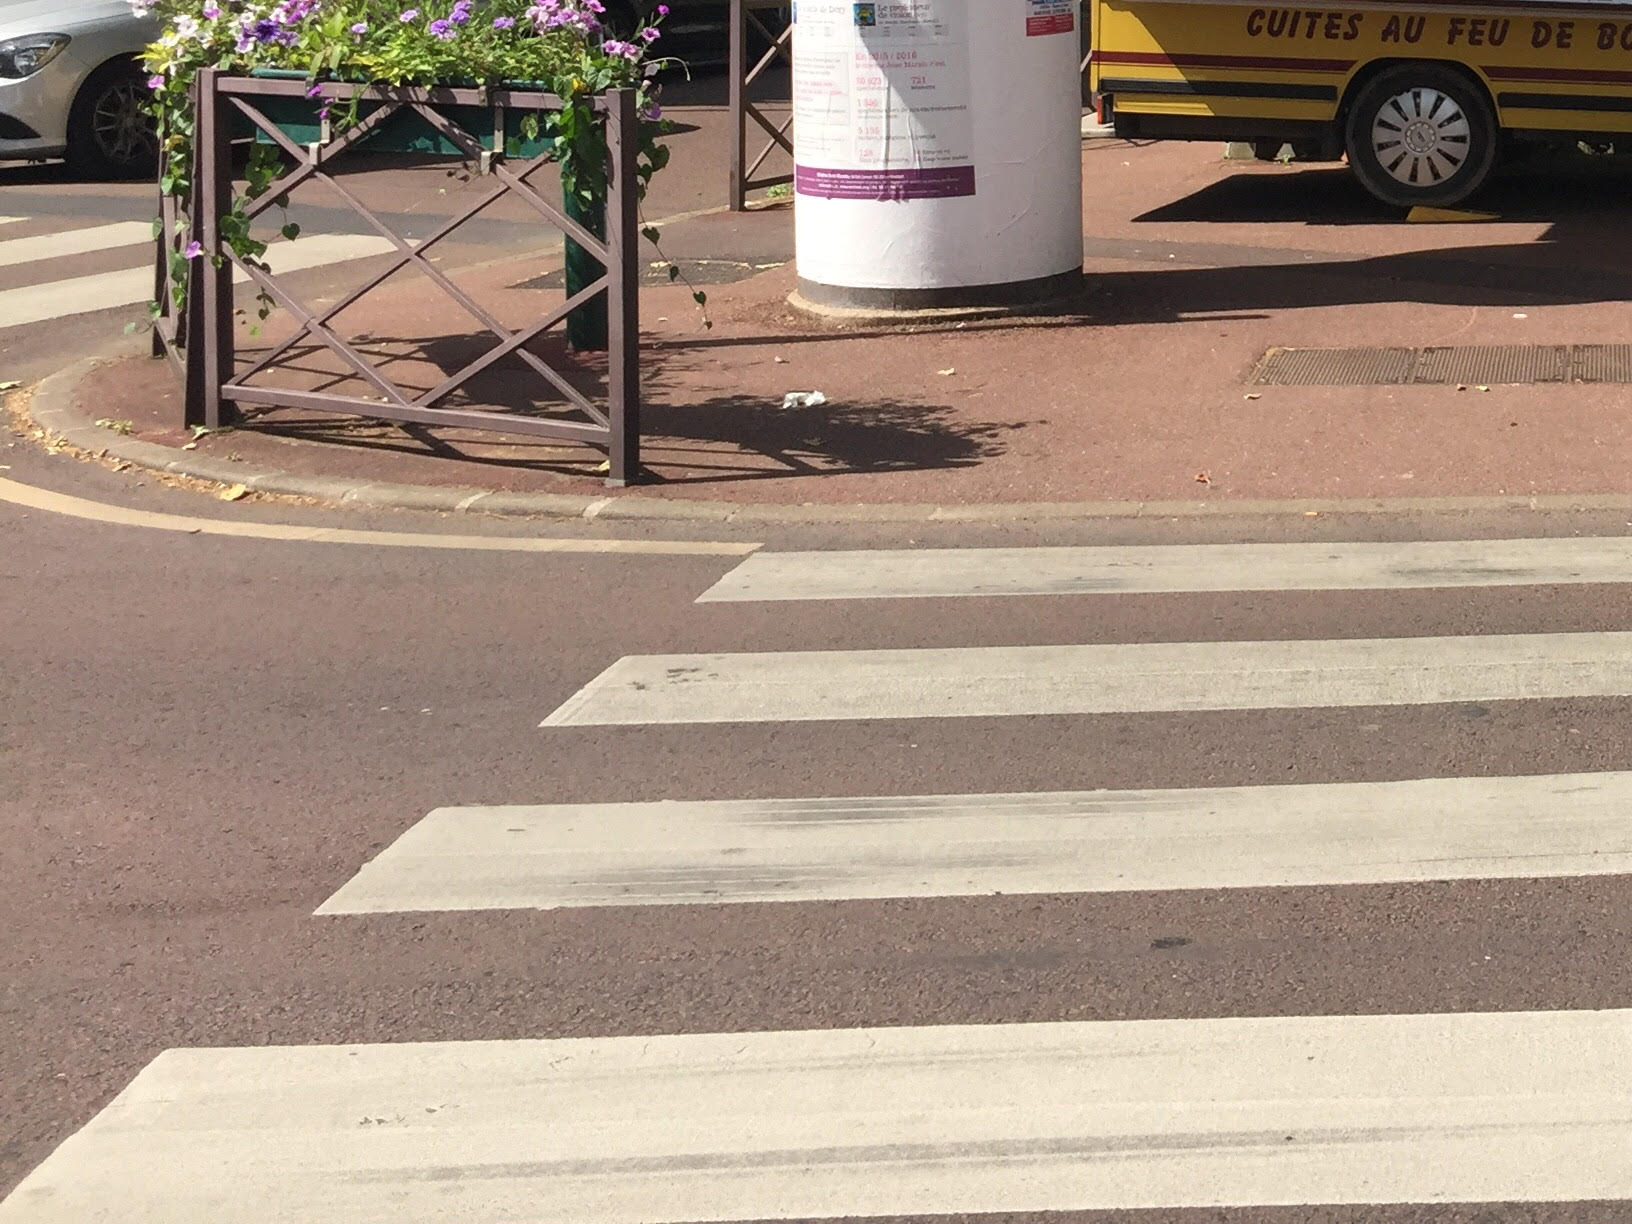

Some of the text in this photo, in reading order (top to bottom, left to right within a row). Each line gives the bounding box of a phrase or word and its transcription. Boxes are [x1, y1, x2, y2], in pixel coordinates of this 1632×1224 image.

[1246, 9, 1364, 41] CUITES
[1381, 15, 1426, 44] AU
[1447, 17, 1510, 47] FEU
[1531, 20, 1575, 49] DE
